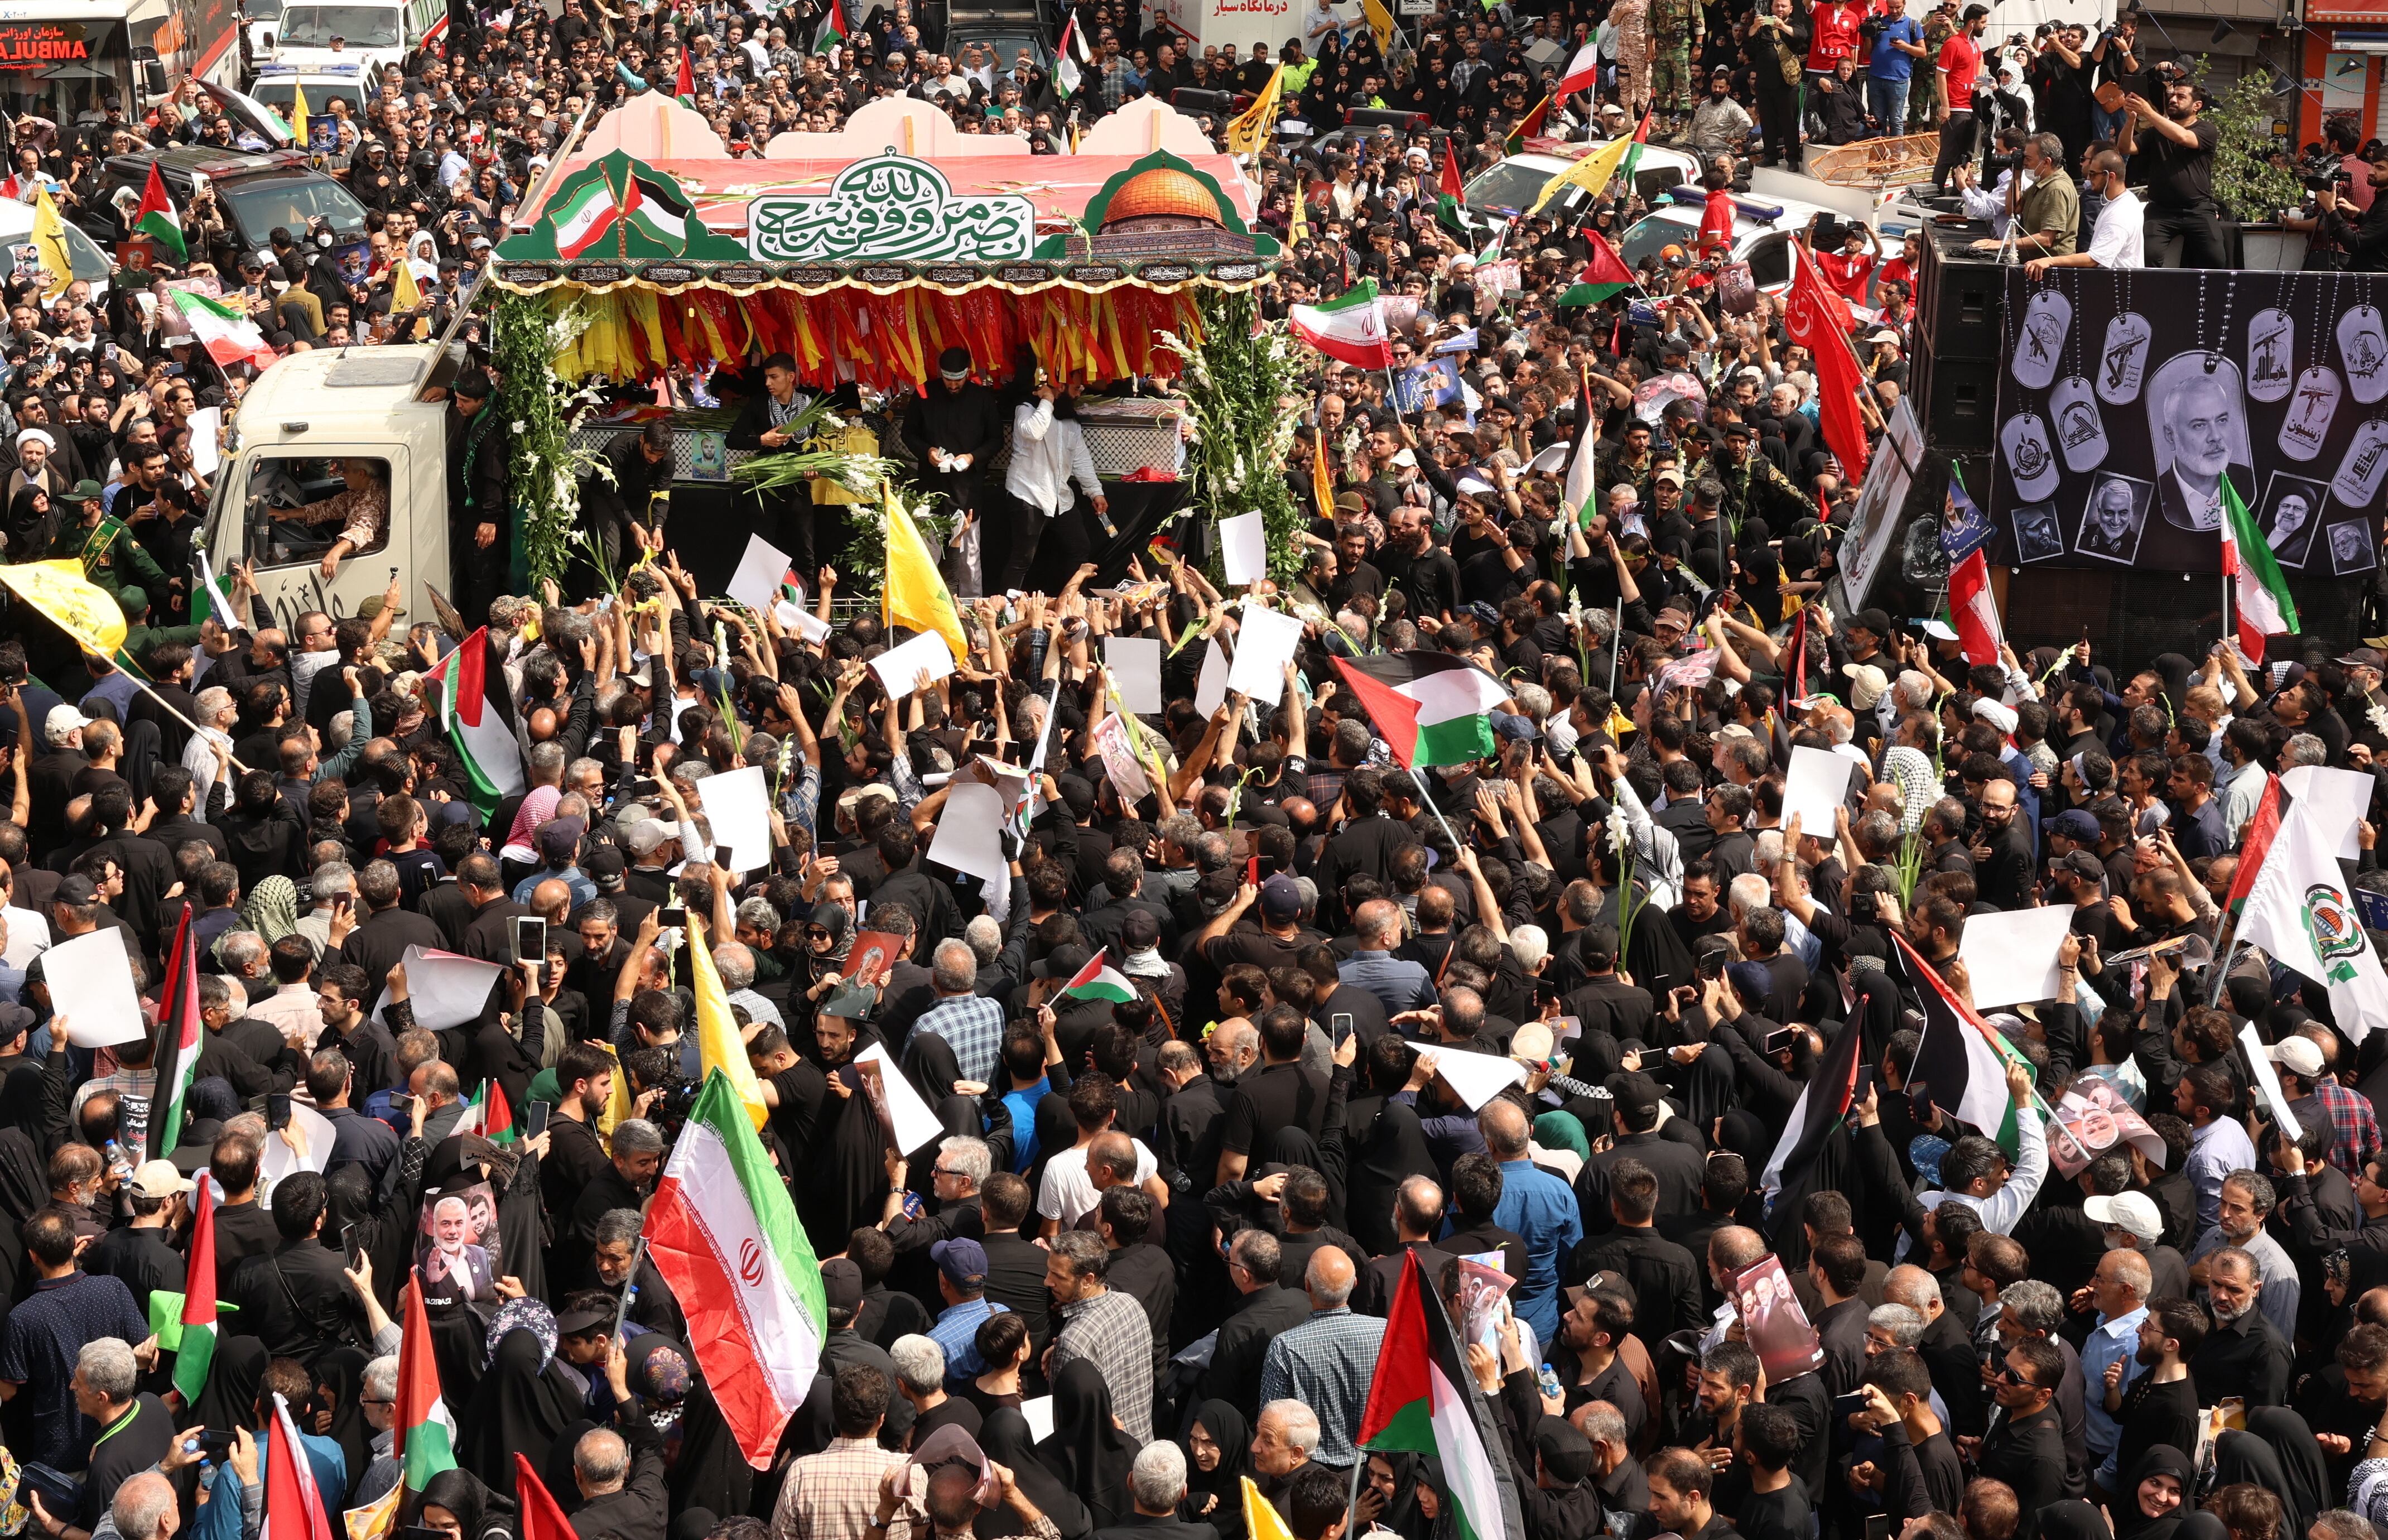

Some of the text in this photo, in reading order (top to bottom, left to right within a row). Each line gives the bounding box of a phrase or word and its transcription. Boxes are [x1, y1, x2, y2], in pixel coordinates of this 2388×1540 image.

[1214, 0, 1288, 16] درمانگاه سیار
[33, 26, 64, 40] سازمان
[905, 1196, 919, 1213] SNN
